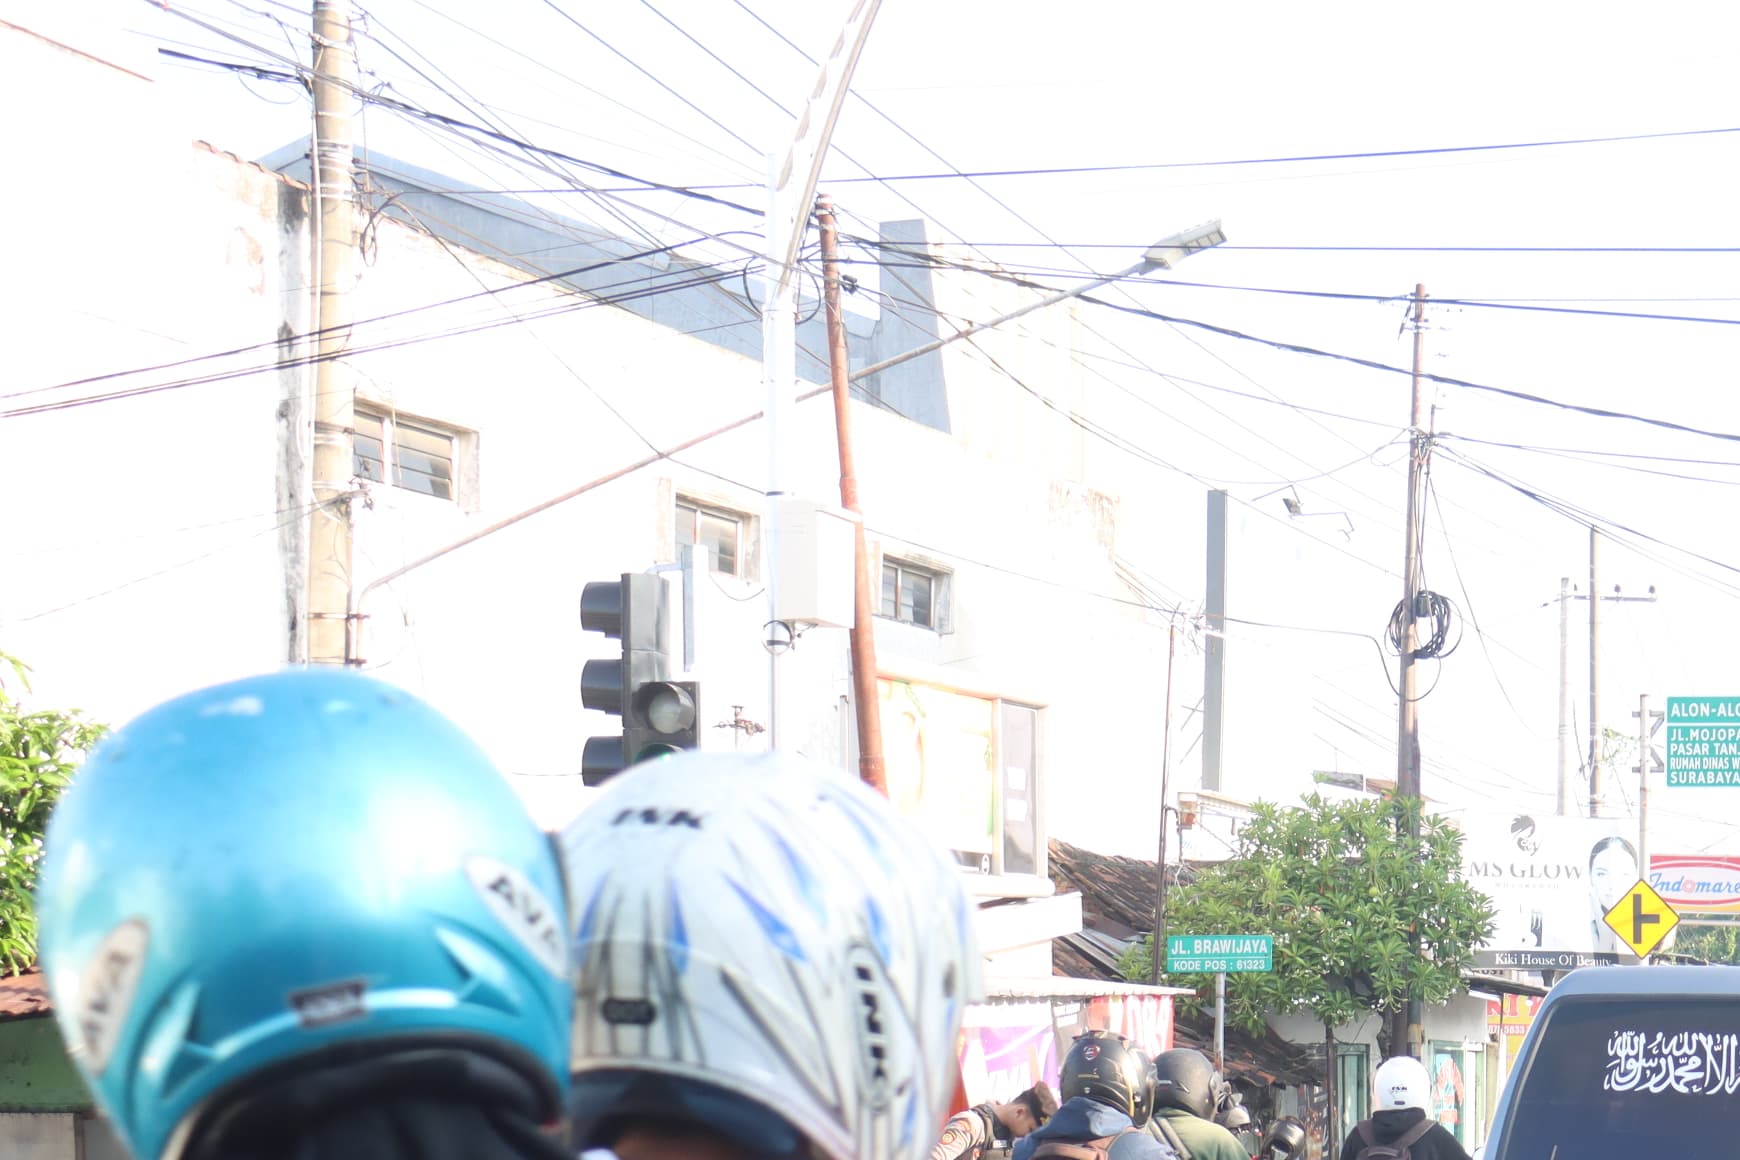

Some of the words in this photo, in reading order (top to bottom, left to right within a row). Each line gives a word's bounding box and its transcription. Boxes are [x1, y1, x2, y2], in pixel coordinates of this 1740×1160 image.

[1670, 742, 1709, 755] PASAR
[1670, 757, 1701, 769] RUMAH
[1702, 757, 1729, 769] DINAS
[1670, 771, 1740, 784] SURABAYA
[1469, 861, 1503, 878] MS
[1509, 863, 1583, 880] GLOW
[1171, 940, 1191, 955] JL.
[1194, 938, 1268, 954] BRAWIJAYA
[1173, 960, 1201, 971] KODE
[1204, 960, 1227, 971] POS
[1236, 959, 1265, 970] 61323
[1495, 953, 1518, 965] Kiki
[1521, 953, 1556, 966] House
[1558, 953, 1575, 966] Of
